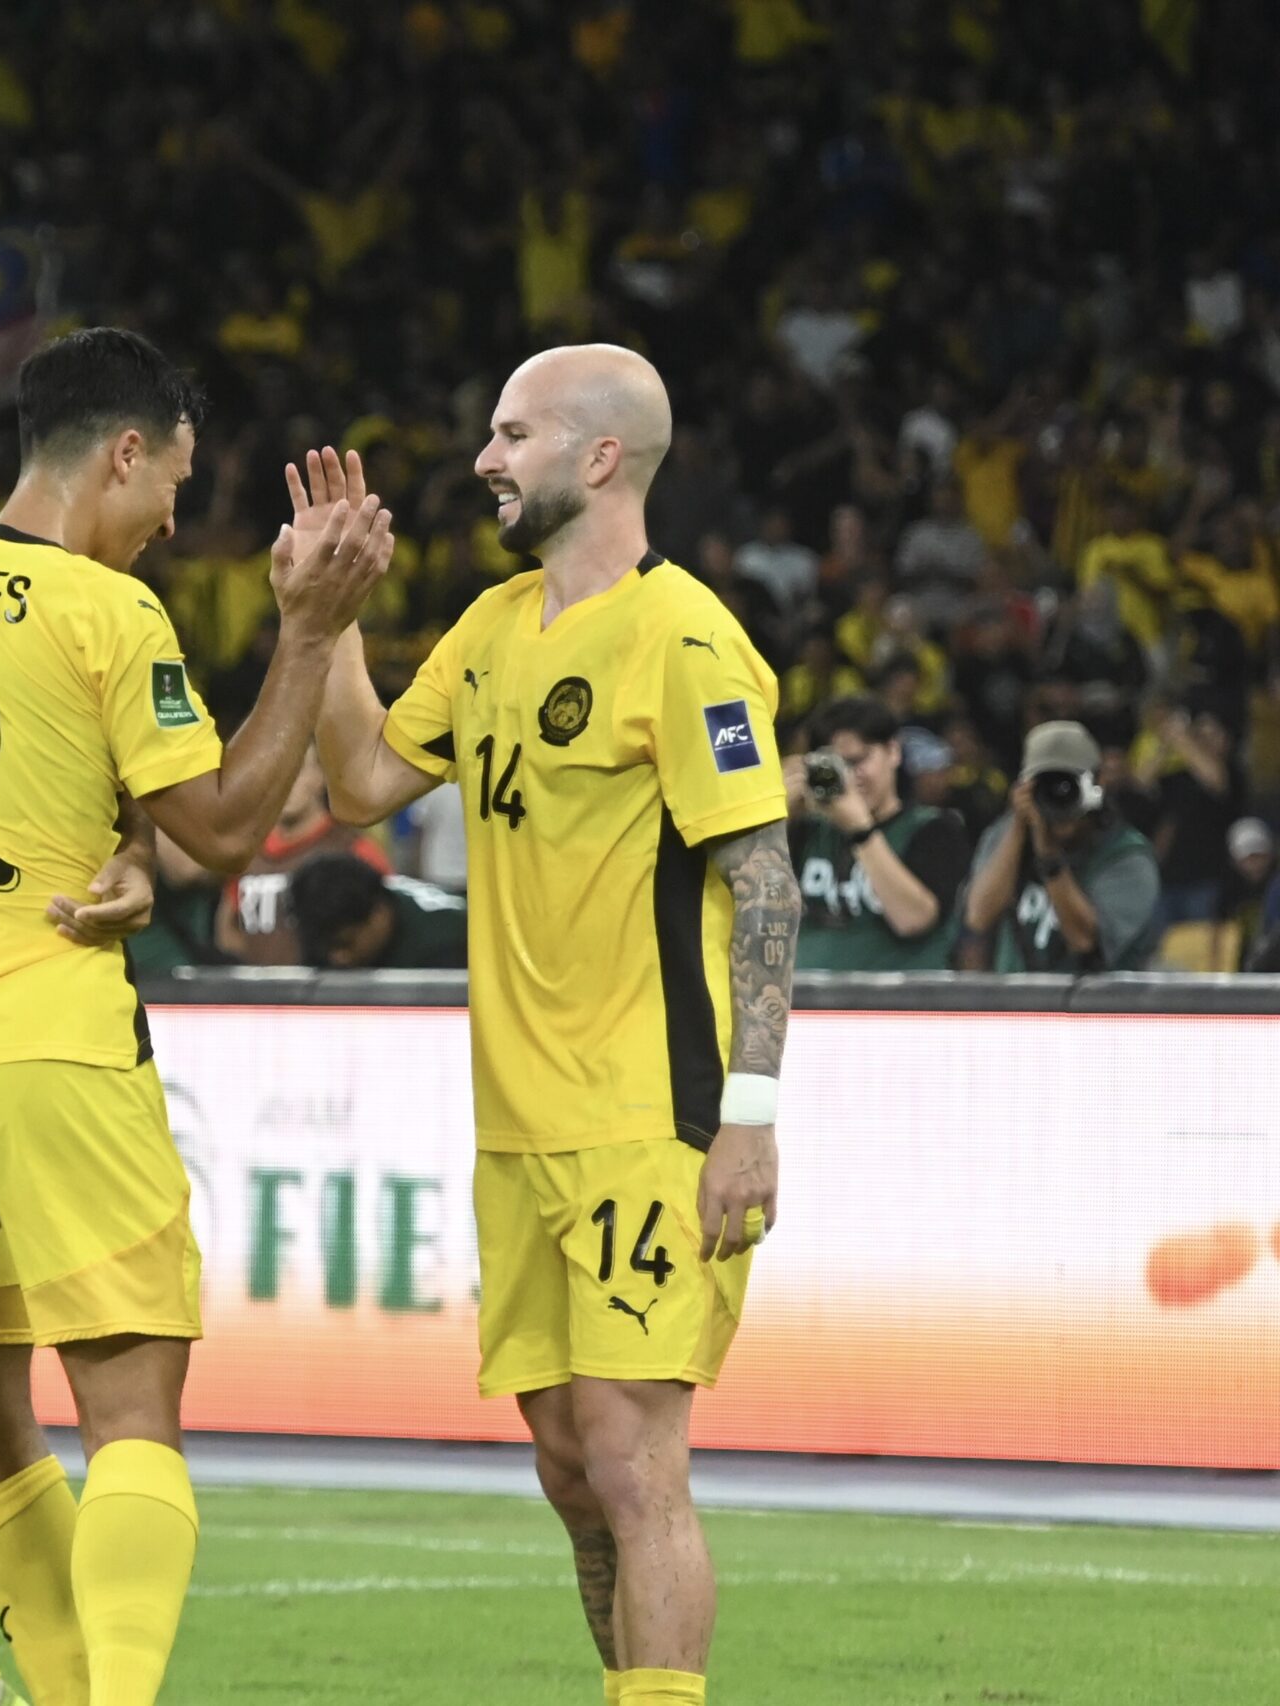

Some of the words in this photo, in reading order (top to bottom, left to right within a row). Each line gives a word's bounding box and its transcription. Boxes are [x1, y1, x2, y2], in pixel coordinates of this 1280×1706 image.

[714, 723, 749, 747] AFC
[475, 734, 526, 832] 14
[764, 939, 785, 966] 09
[247, 1166, 480, 1313] FIE
[591, 1198, 676, 1288] 14
